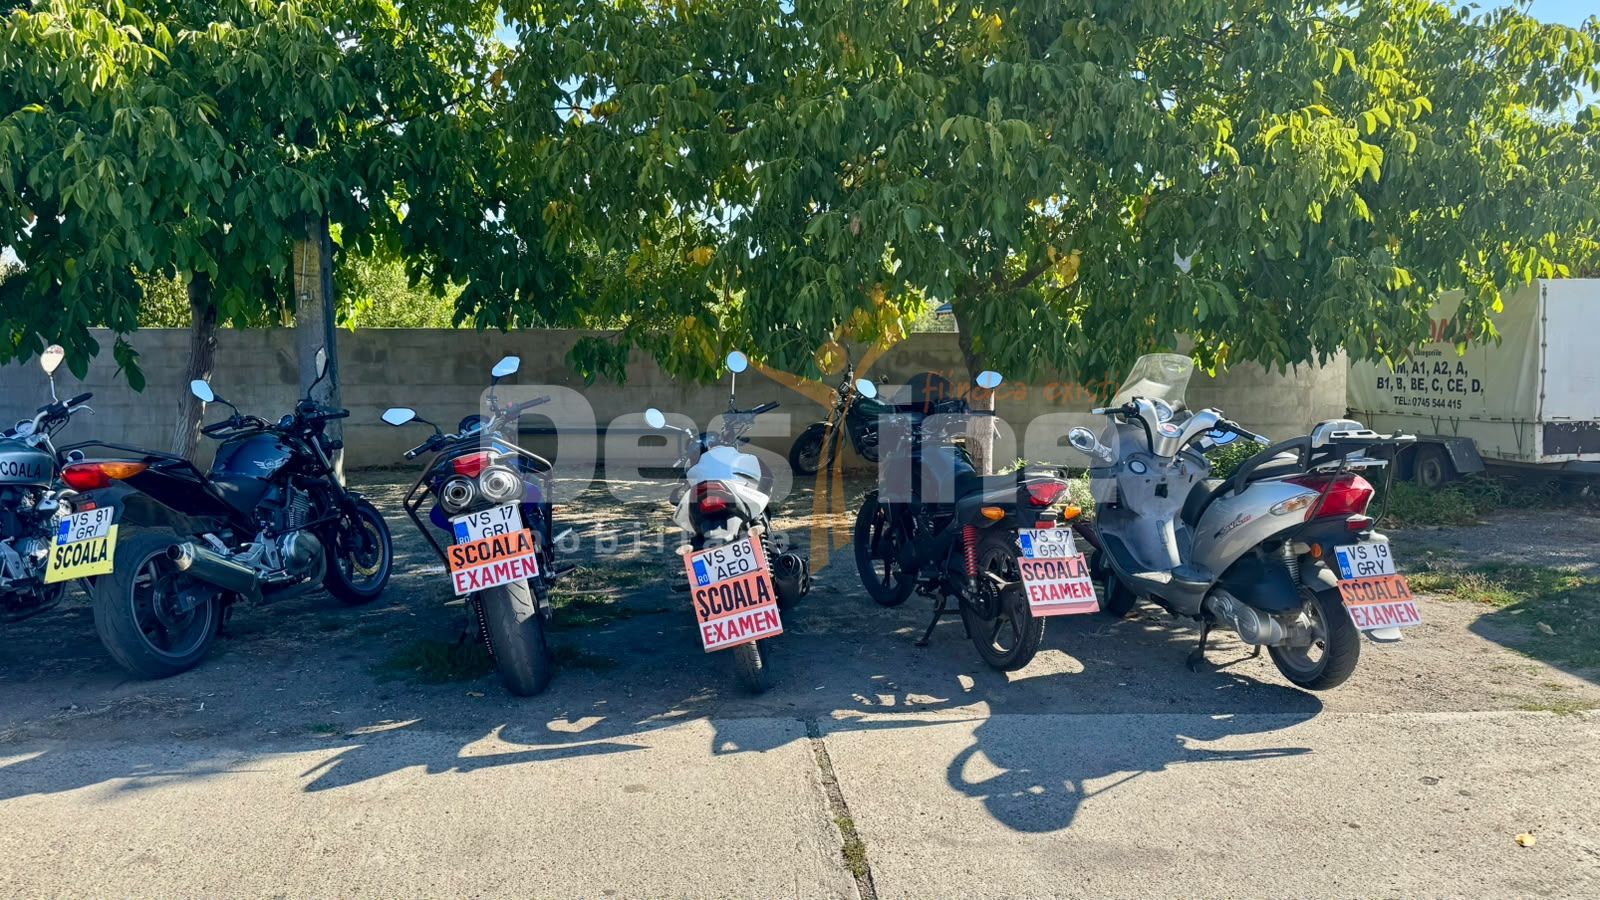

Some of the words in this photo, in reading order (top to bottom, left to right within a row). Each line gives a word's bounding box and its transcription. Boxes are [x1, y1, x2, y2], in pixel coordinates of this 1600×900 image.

[1391, 362, 1409, 377] M,
[1412, 361, 1430, 377] A1,
[1433, 361, 1452, 377] A2,
[1455, 361, 1468, 378] A,
[1377, 377, 1393, 391] B1,
[1396, 378, 1406, 392] B,
[1410, 379, 1428, 394] BE,
[1431, 379, 1444, 395] C,
[1447, 379, 1467, 396] CE,
[1471, 379, 1484, 396] D,
[1412, 397, 1430, 408] 0745
[1432, 398, 1446, 409] 544
[1447, 399, 1462, 409] 415
[71, 513, 89, 527] VS
[95, 508, 109, 522] 81
[468, 511, 491, 528] VS
[499, 505, 514, 520] 17
[75, 525, 98, 539] GRI
[482, 522, 510, 538] GRI
[1029, 530, 1049, 543] VS
[1054, 530, 1070, 542] 97
[702, 550, 725, 567] VS
[732, 541, 751, 557] 86
[1040, 544, 1066, 557] GRY
[1347, 546, 1368, 560] VS
[1373, 544, 1388, 558] 19
[455, 556, 536, 593] EXAMEN
[1357, 560, 1385, 575] GRY
[1029, 581, 1092, 602] EXAMEN
[1350, 602, 1420, 627] EXAMEN
[702, 608, 779, 646] EXAMEN
